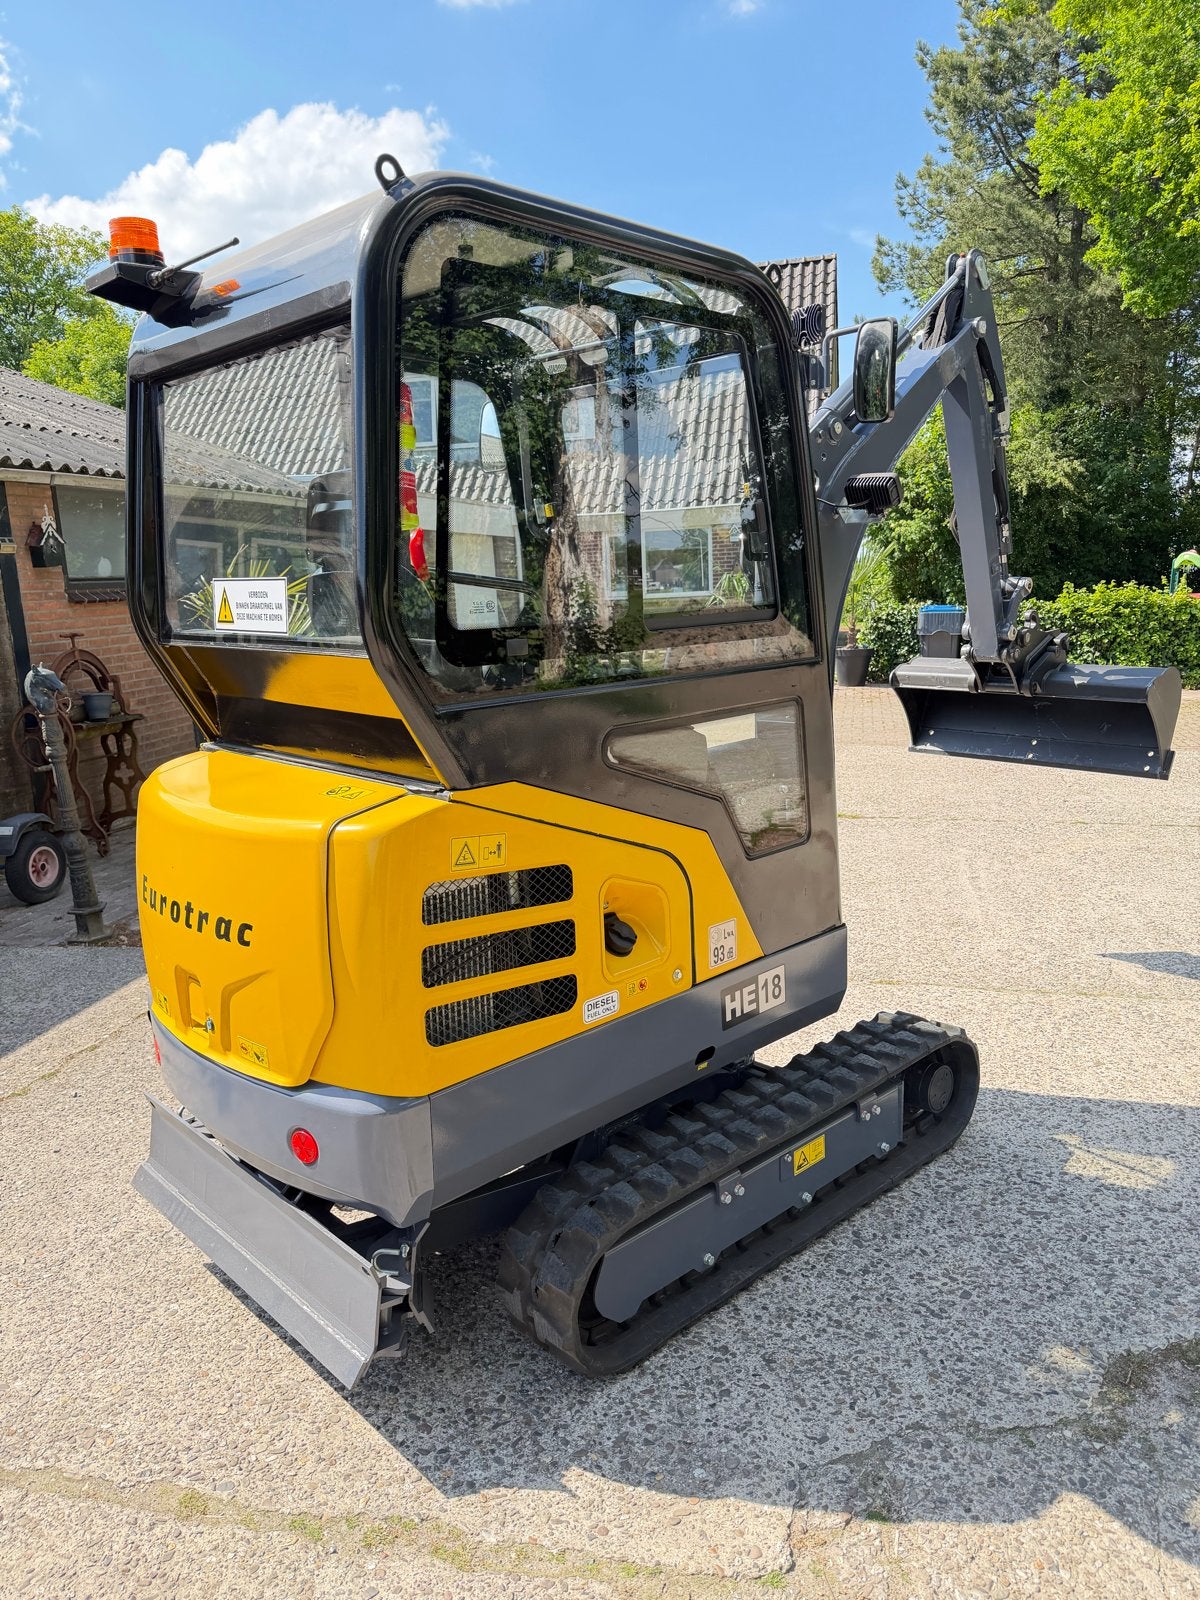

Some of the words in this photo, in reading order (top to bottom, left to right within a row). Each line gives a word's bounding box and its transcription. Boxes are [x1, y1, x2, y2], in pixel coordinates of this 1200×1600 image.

[248, 590, 269, 599] VERBODEN
[235, 601, 249, 609] BINNEN
[274, 602, 283, 610] VAN
[246, 612, 263, 621] MACHINE
[263, 613, 268, 621] TE
[142, 873, 254, 947] Eurotrac
[713, 944, 725, 964] 93
[726, 947, 734, 959] dB
[587, 995, 616, 1012] DIESEL
[725, 983, 757, 1022] HE
[761, 974, 782, 1004] 18
[587, 1010, 601, 1020] FUEL
[601, 1005, 616, 1014] ONLY
